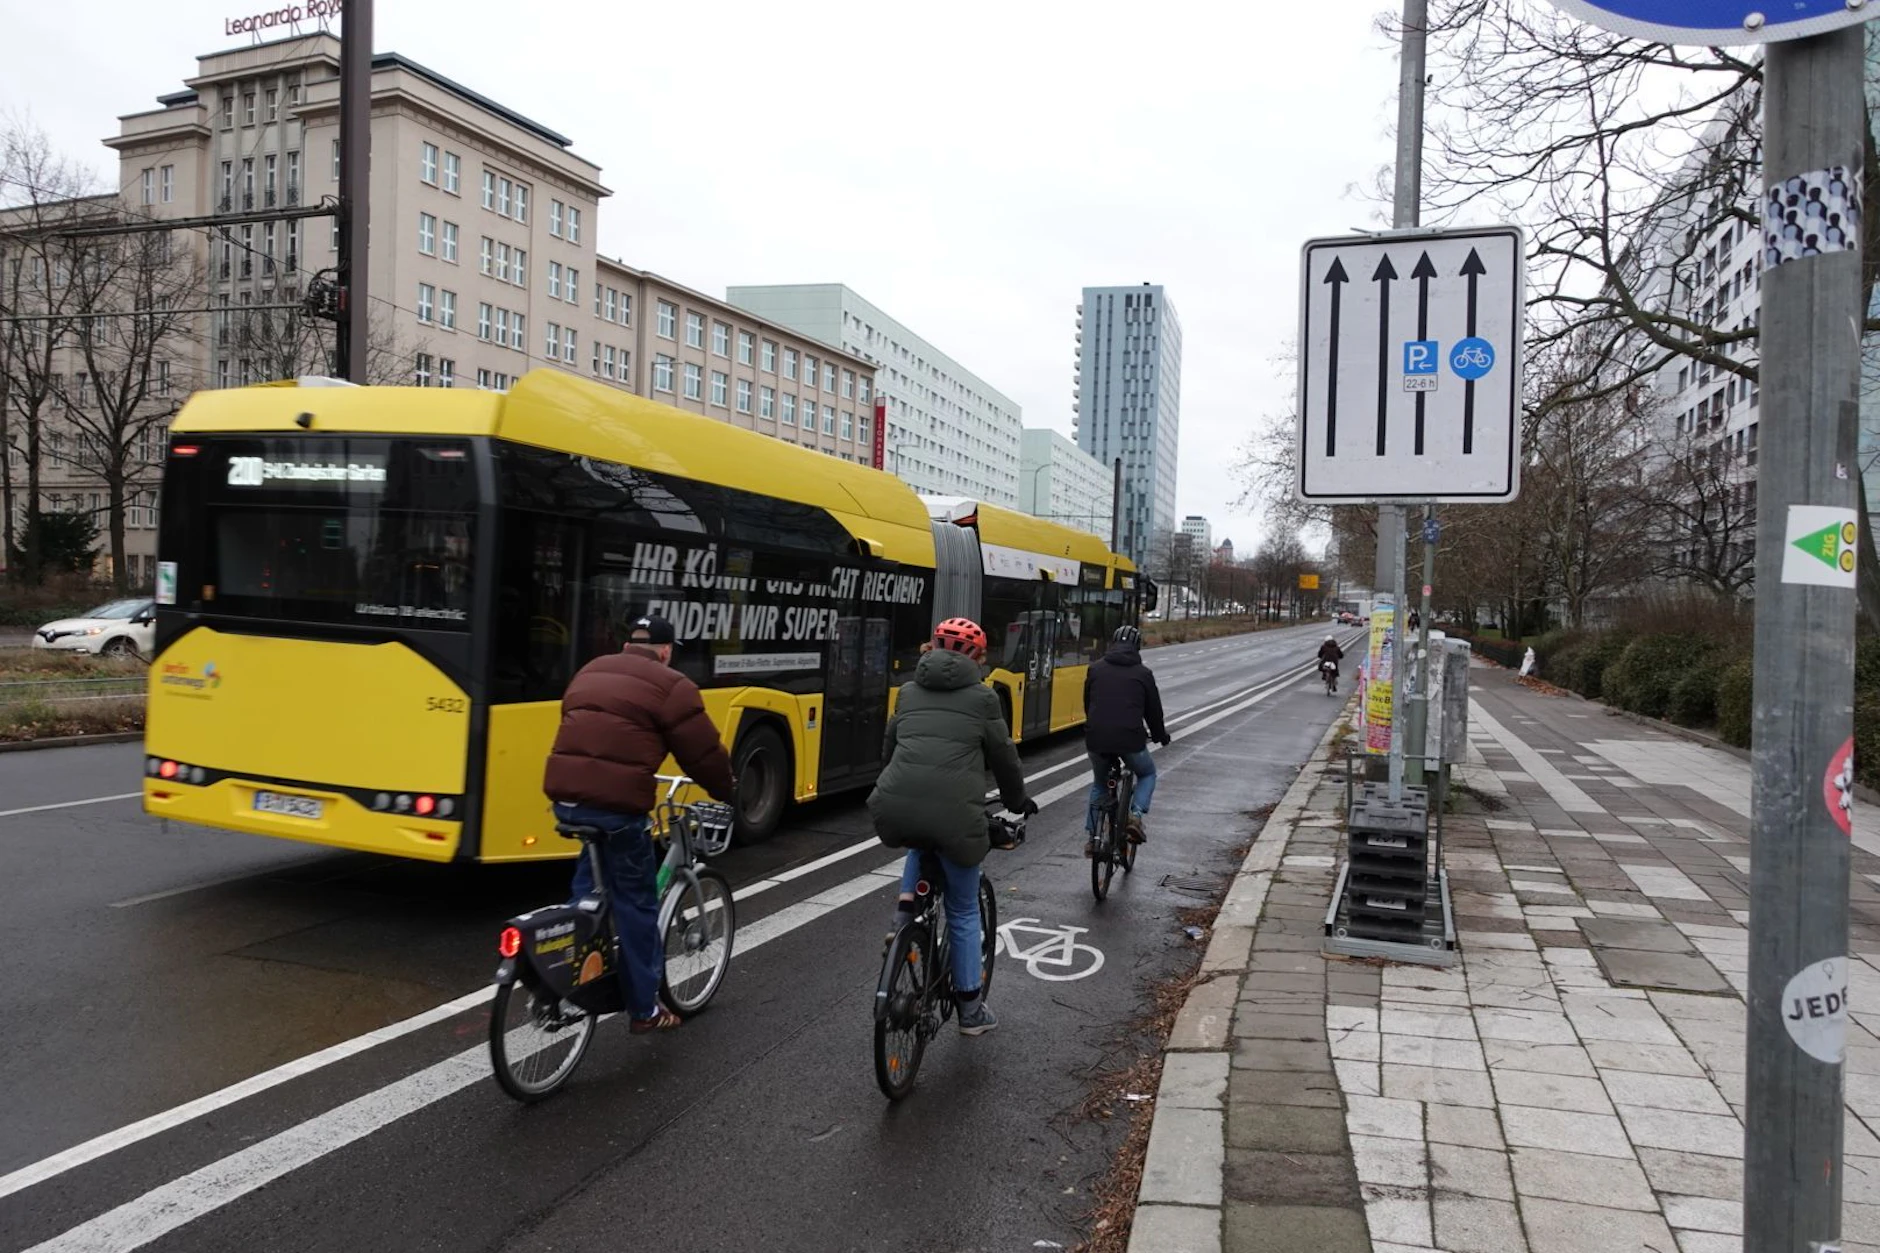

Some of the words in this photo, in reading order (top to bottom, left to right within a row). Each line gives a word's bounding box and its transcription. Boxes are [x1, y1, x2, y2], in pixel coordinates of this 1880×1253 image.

[225, 4, 301, 36] Leonardo
[1409, 345, 1428, 371] P
[1406, 379, 1426, 389] 22-6
[1429, 379, 1435, 388] h
[1822, 533, 1836, 558] ZIG
[629, 542, 678, 586] IHR
[861, 570, 925, 605] RIECHEN?
[740, 604, 779, 640] WIR
[781, 606, 840, 640] SUPER.
[426, 696, 465, 713] 5432
